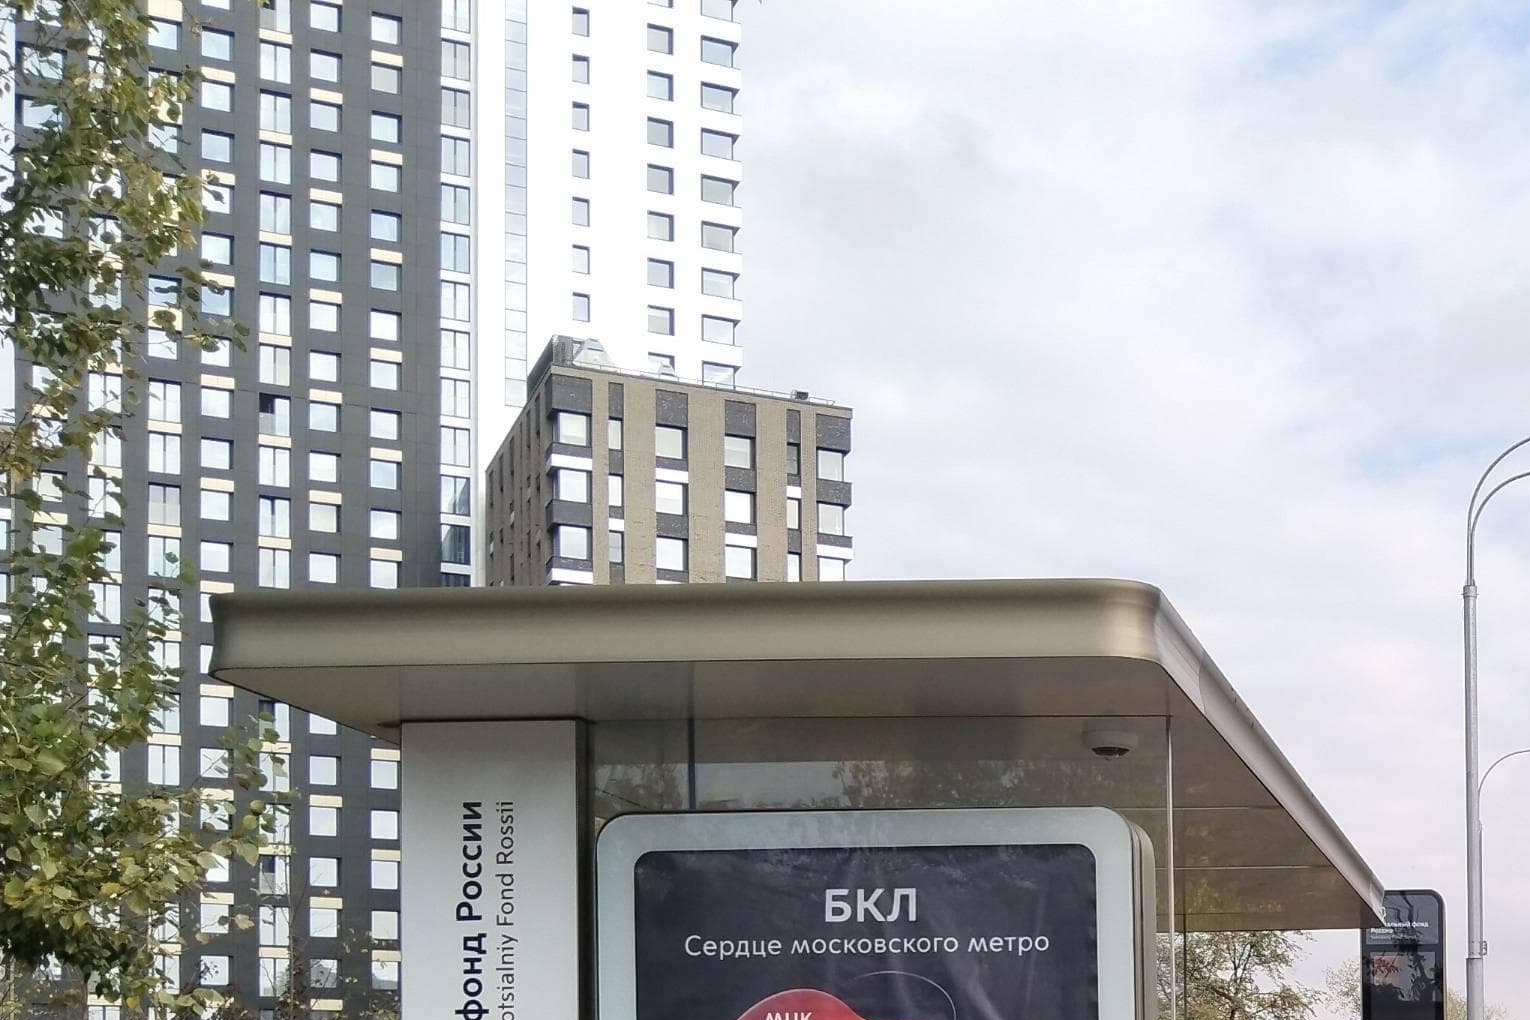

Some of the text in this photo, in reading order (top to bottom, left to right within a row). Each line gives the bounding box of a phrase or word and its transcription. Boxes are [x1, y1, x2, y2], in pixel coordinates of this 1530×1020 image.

[495, 801, 514, 865] Rossii
[456, 801, 483, 921] России
[495, 873, 515, 926] Fond
[825, 887, 917, 923] БКЛ
[684, 934, 1050, 960] Сердце московского метро
